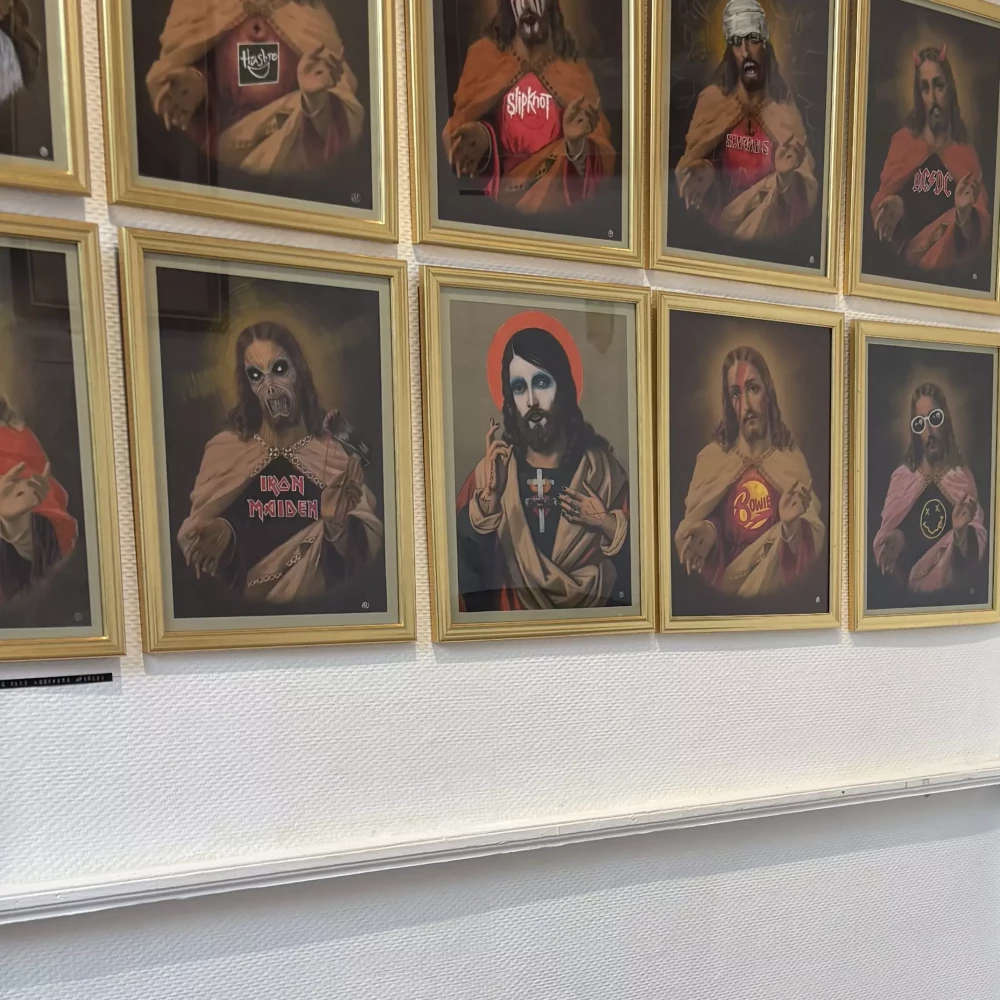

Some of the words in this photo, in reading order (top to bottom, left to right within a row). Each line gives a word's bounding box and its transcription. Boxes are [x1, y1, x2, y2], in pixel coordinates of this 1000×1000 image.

[240, 48, 278, 69] Hasbro
[260, 475, 305, 497] IRON
[247, 499, 319, 523] MAIDEN
